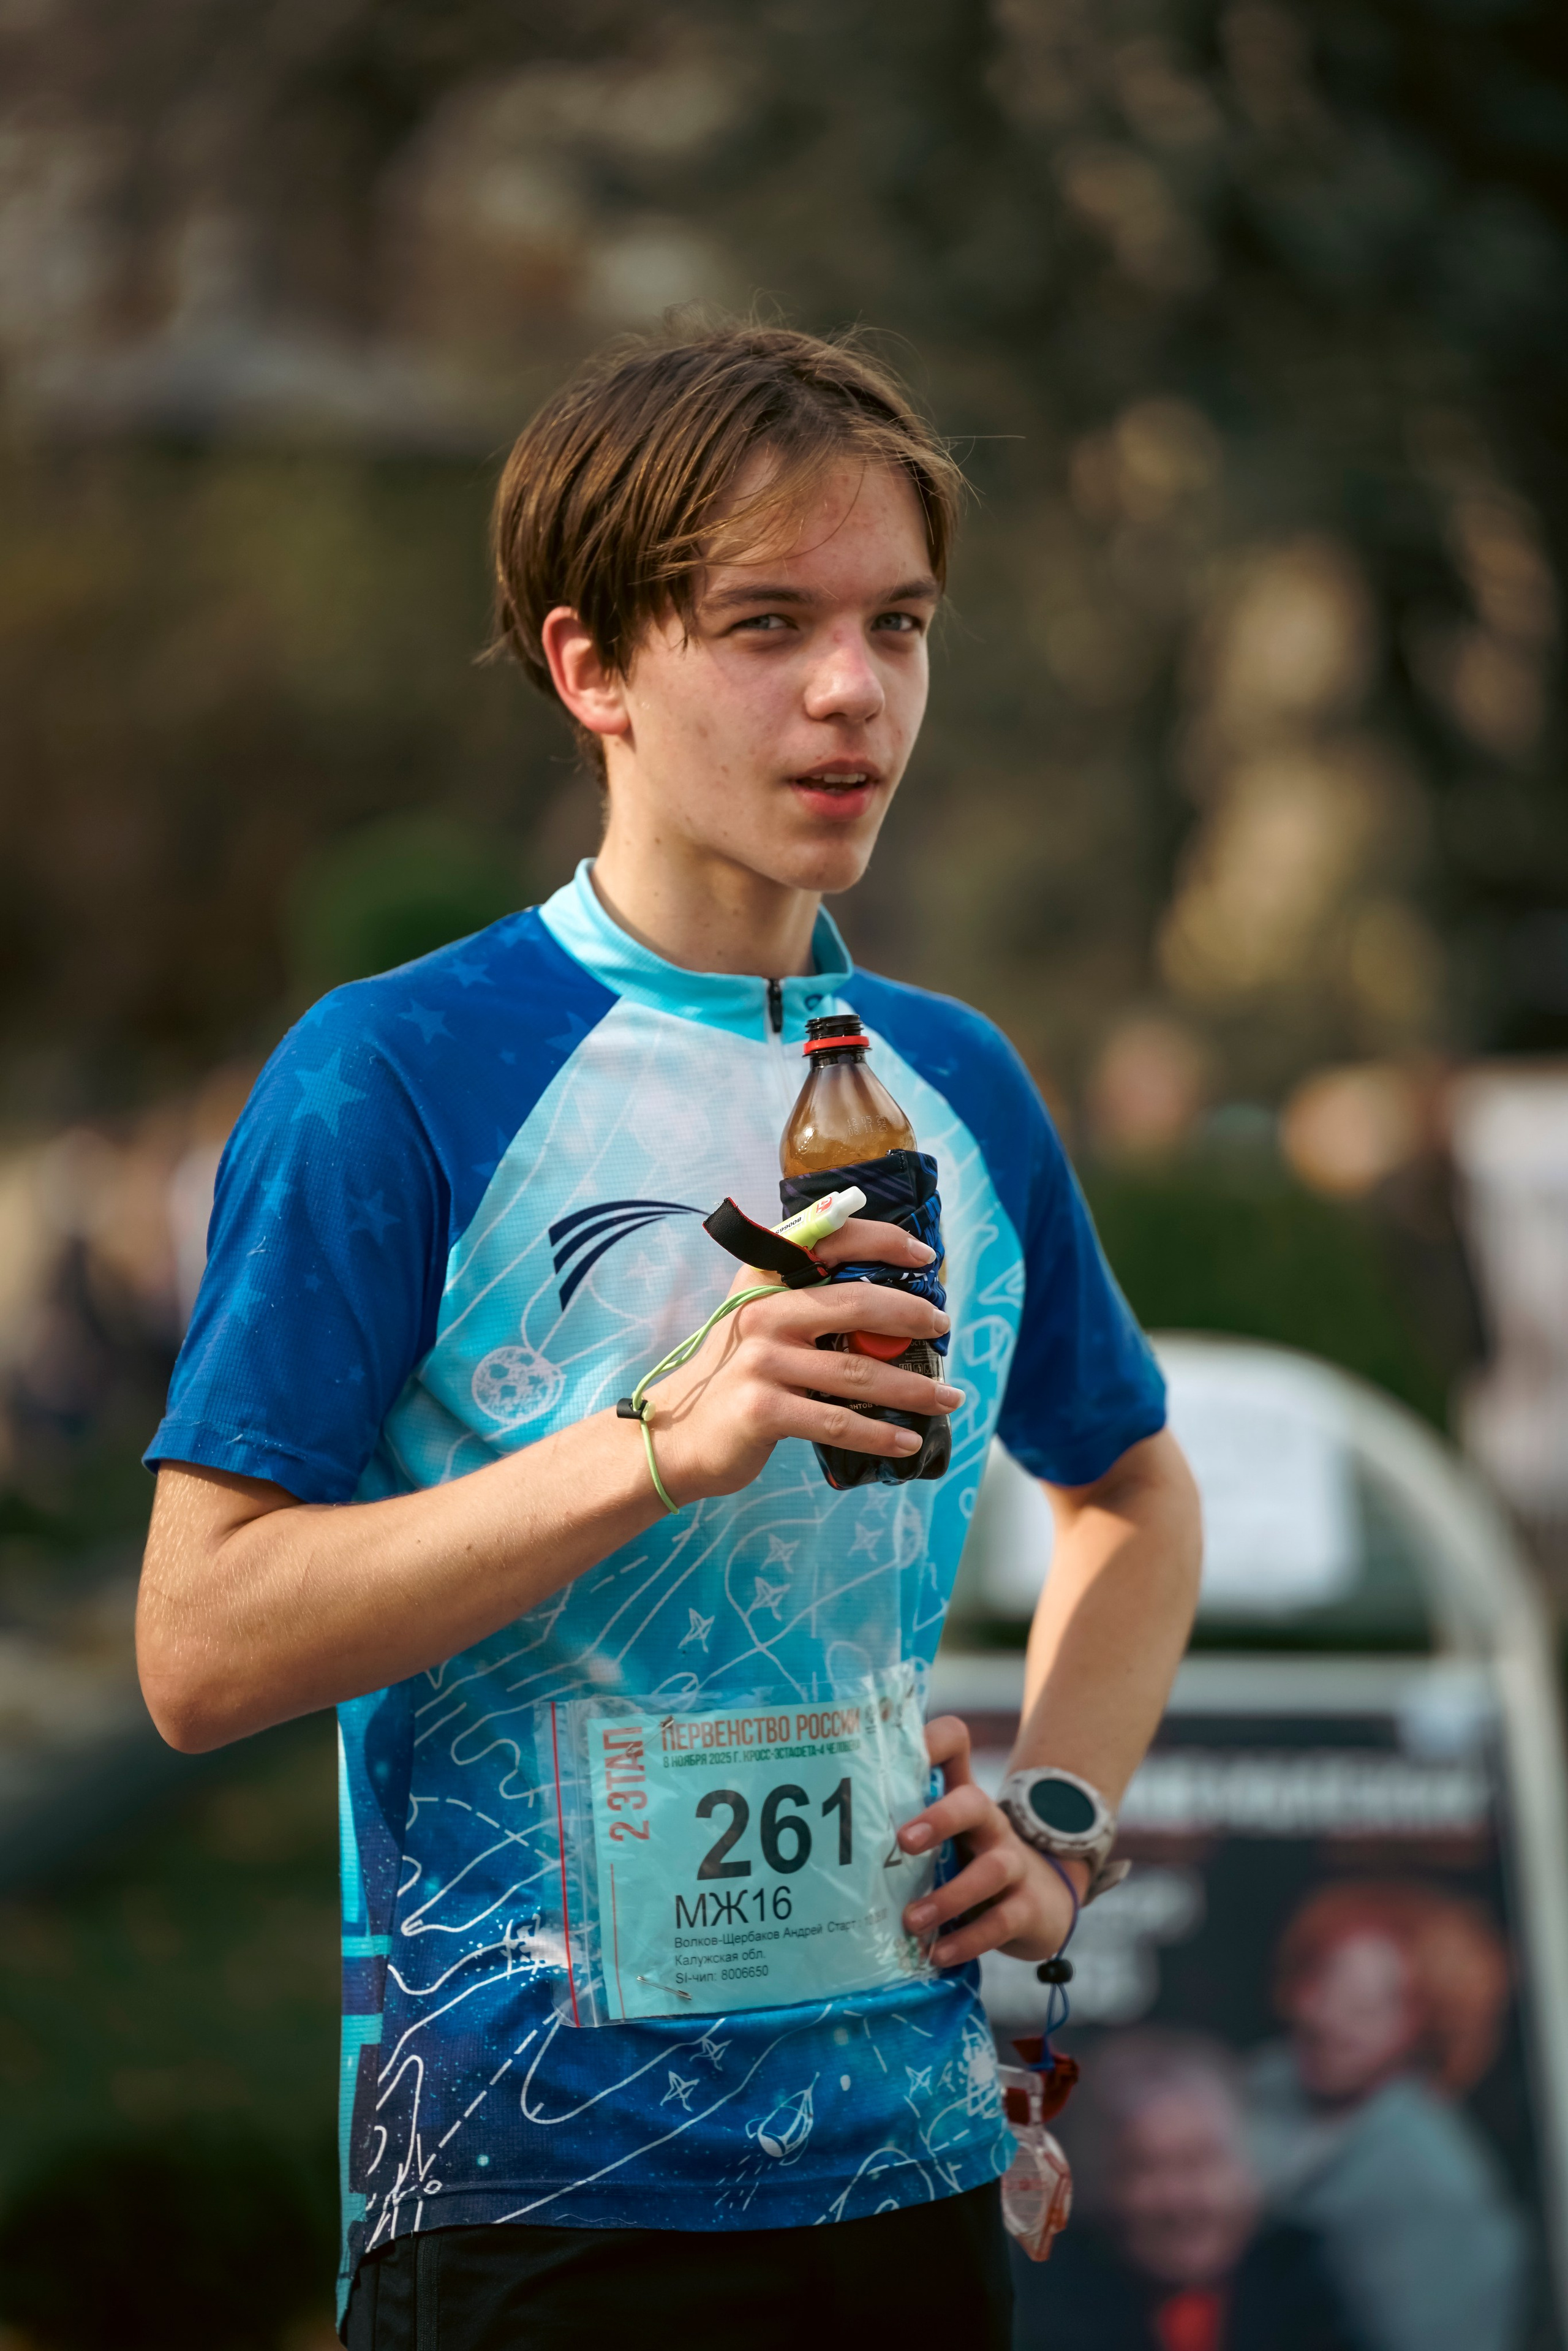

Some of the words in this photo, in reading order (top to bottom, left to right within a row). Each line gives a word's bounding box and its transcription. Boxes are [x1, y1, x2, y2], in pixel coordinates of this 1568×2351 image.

[775, 1217, 802, 1234] 800665
[662, 1715, 791, 1751] ПЕРВЕНСТВО
[796, 1707, 861, 1741] РОССИИ
[602, 1726, 648, 1812] ЭТАП
[663, 1757, 669, 1768] 8
[671, 1753, 707, 1768] НОЯБРЯ
[709, 1752, 732, 1765] 2025
[608, 1820, 651, 1842] 2
[695, 1778, 852, 1881] 261
[675, 1885, 793, 1930] МЖ16
[674, 1930, 780, 1949] Волков-Щербаков
[783, 1923, 823, 1939] Андрей
[675, 1951, 739, 1967] Калужская
[742, 1948, 766, 1961] обл.
[721, 1965, 769, 1981] 8006650
